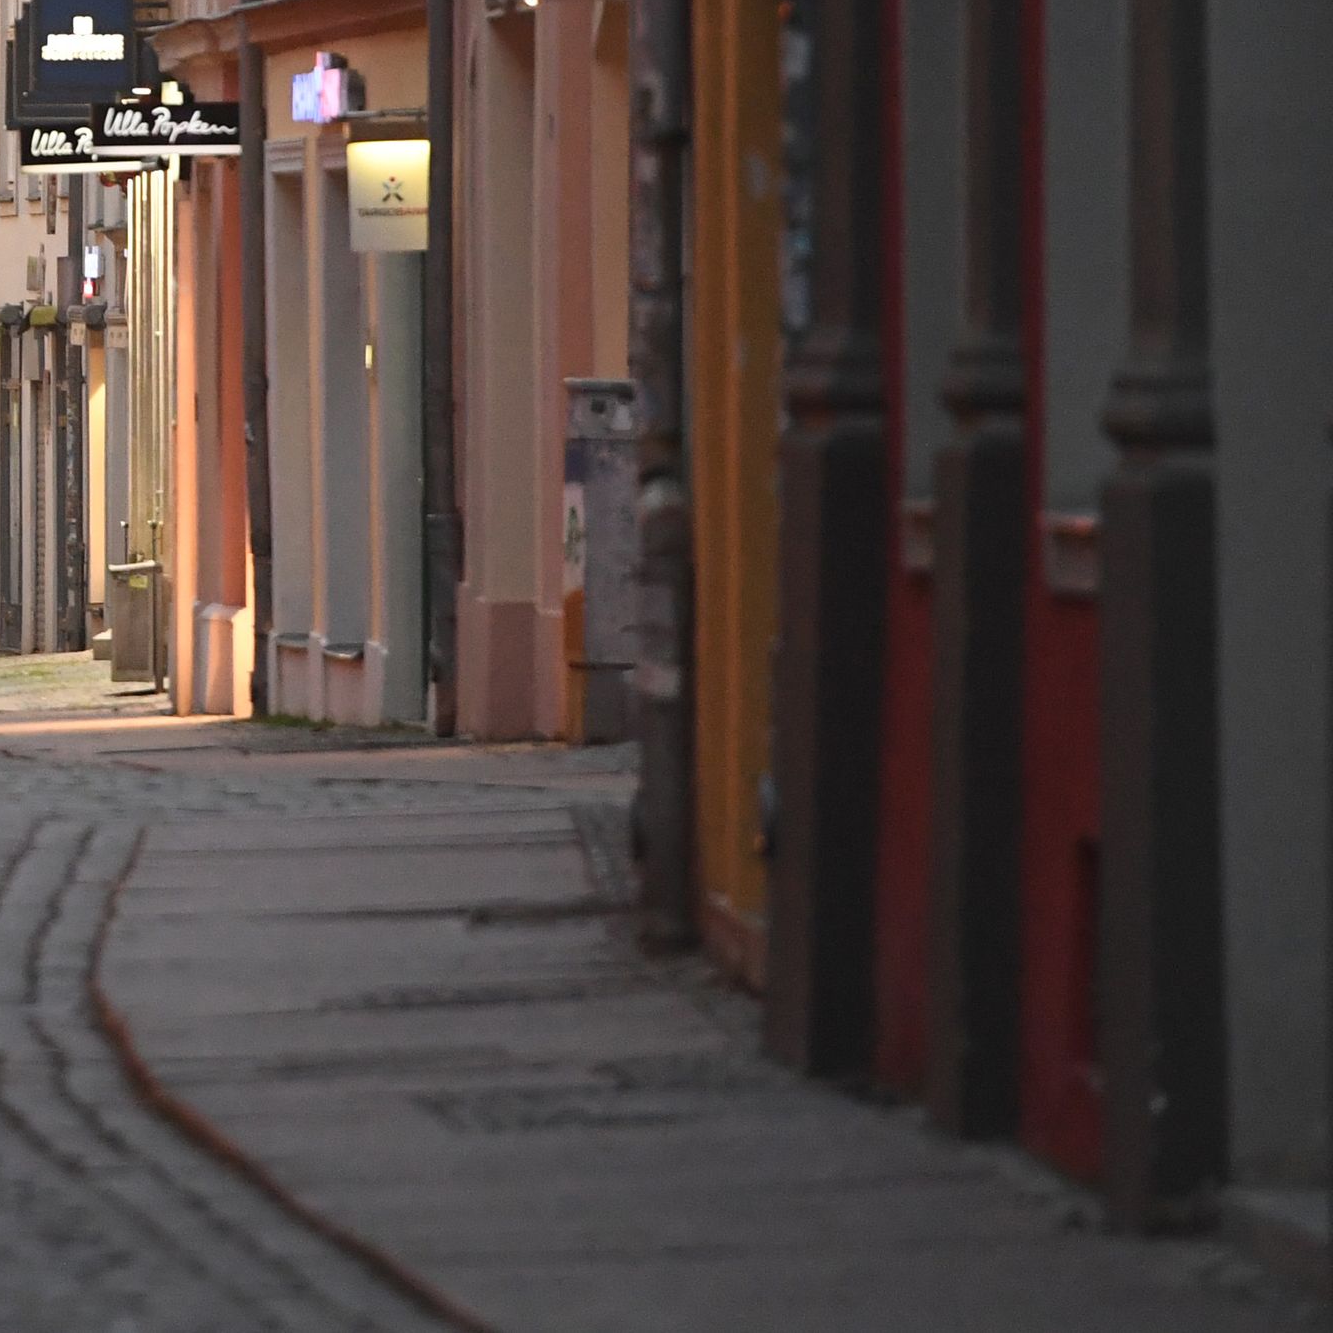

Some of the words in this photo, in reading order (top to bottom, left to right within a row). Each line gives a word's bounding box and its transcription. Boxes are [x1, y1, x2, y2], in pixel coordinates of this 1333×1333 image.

[104, 107, 150, 138] Ulla
[151, 107, 238, 144] Popken
[31, 128, 74, 157] Ulla
